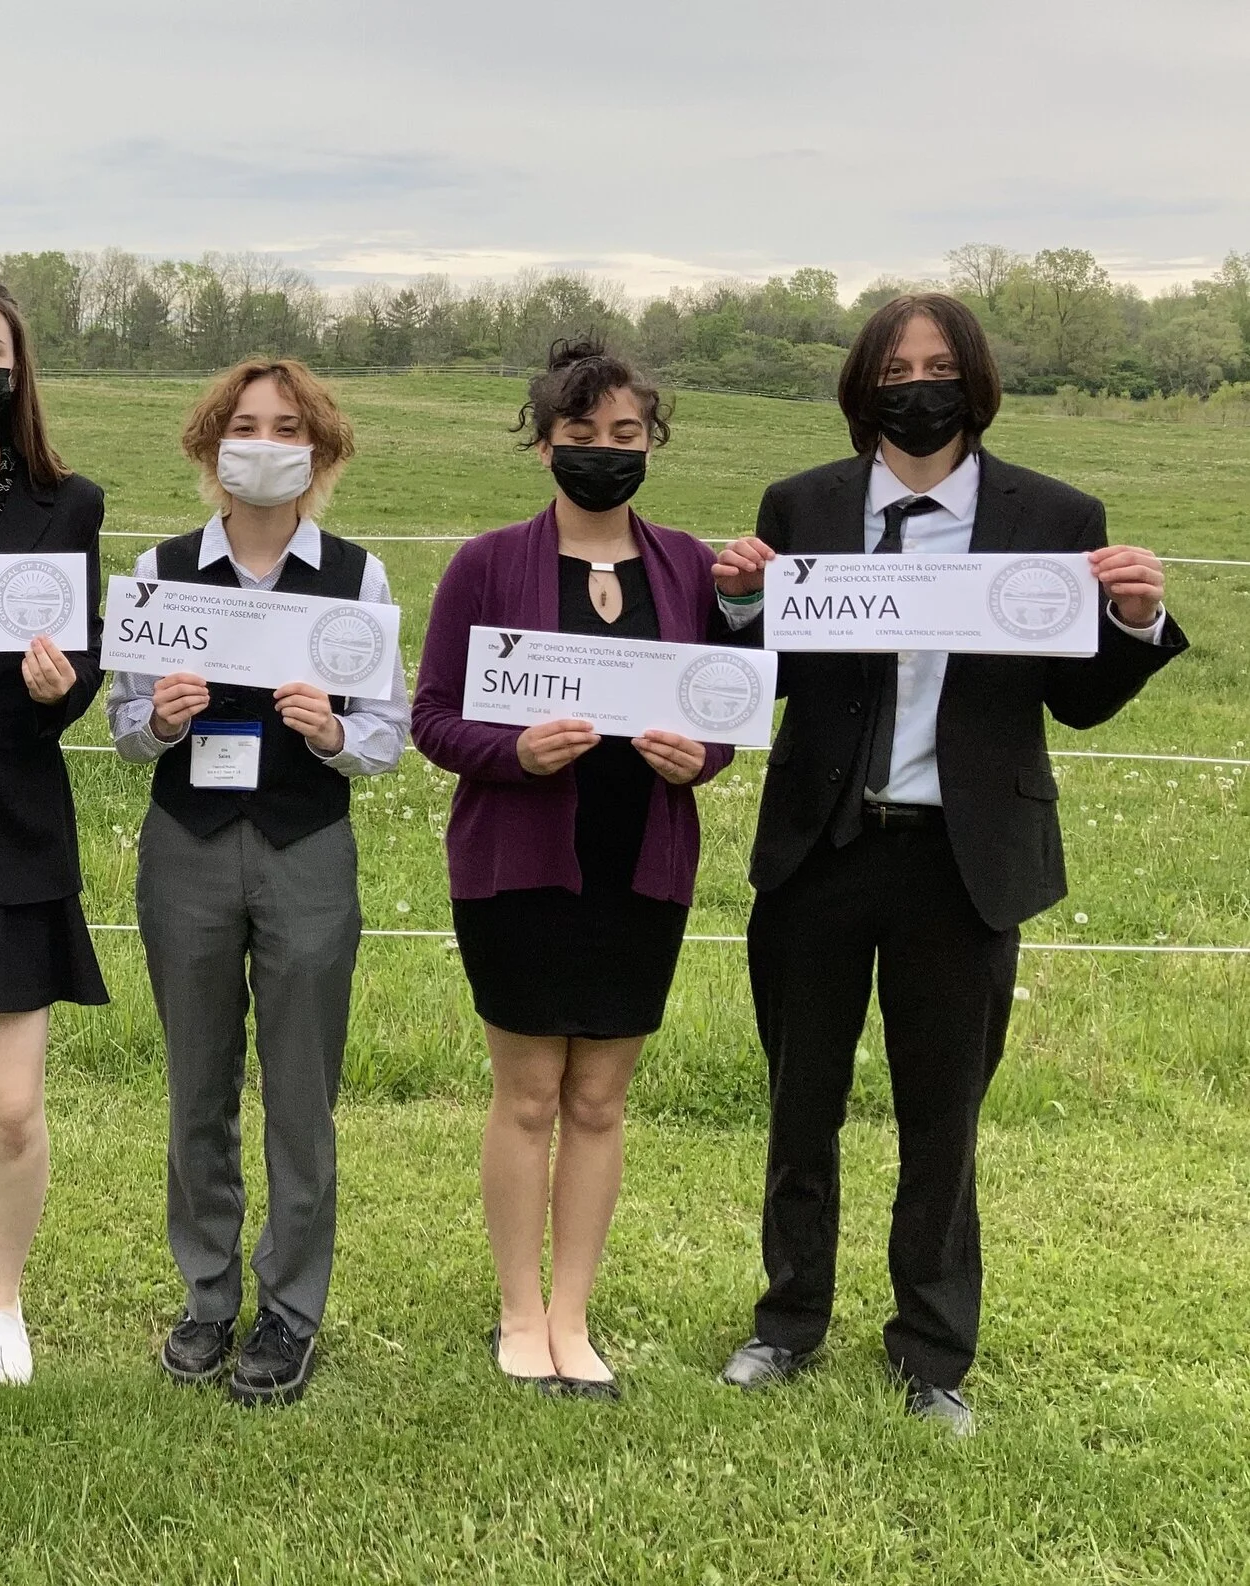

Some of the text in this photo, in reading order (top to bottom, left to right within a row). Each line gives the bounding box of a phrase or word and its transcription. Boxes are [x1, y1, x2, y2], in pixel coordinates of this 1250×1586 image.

[925, 563, 982, 571] GOVERNMENT
[163, 603, 266, 620] HIGH SCHOOL STATE ASSEMBLY
[222, 598, 247, 606] YOUTH
[257, 601, 308, 614] GOVERNMENT
[781, 595, 901, 620] AMAYA
[119, 618, 208, 650] SALAS
[109, 651, 146, 660] LEGISLATURE
[205, 661, 229, 670] CENTRAL
[544, 644, 563, 652] OHIO
[565, 646, 587, 654] YMCA
[589, 648, 615, 656] YOUTH
[624, 651, 676, 661] GOVERNMENT
[546, 655, 573, 663] SCHOOL
[574, 658, 595, 666] STATE
[597, 659, 634, 669] ASSEMBLY
[482, 669, 581, 701] SMITH
